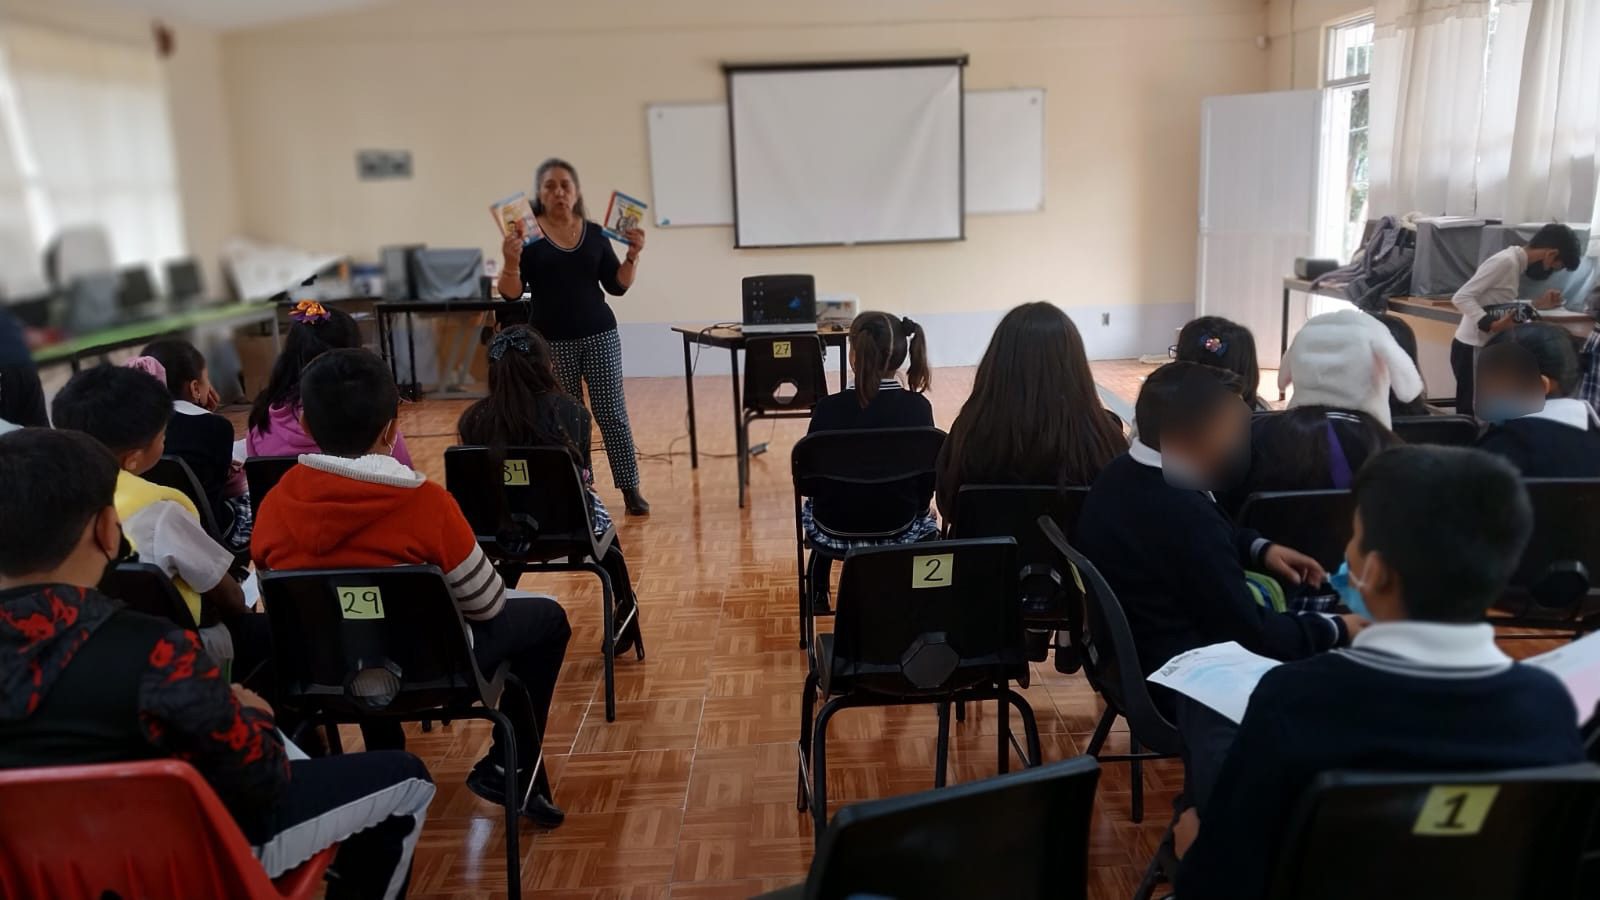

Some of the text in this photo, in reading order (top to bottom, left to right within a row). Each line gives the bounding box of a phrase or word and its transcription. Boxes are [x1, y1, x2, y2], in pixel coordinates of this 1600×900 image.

[775, 343, 789, 355] 27
[923, 558, 944, 582] 2
[343, 591, 379, 614] 29
[1434, 791, 1469, 829] 1
